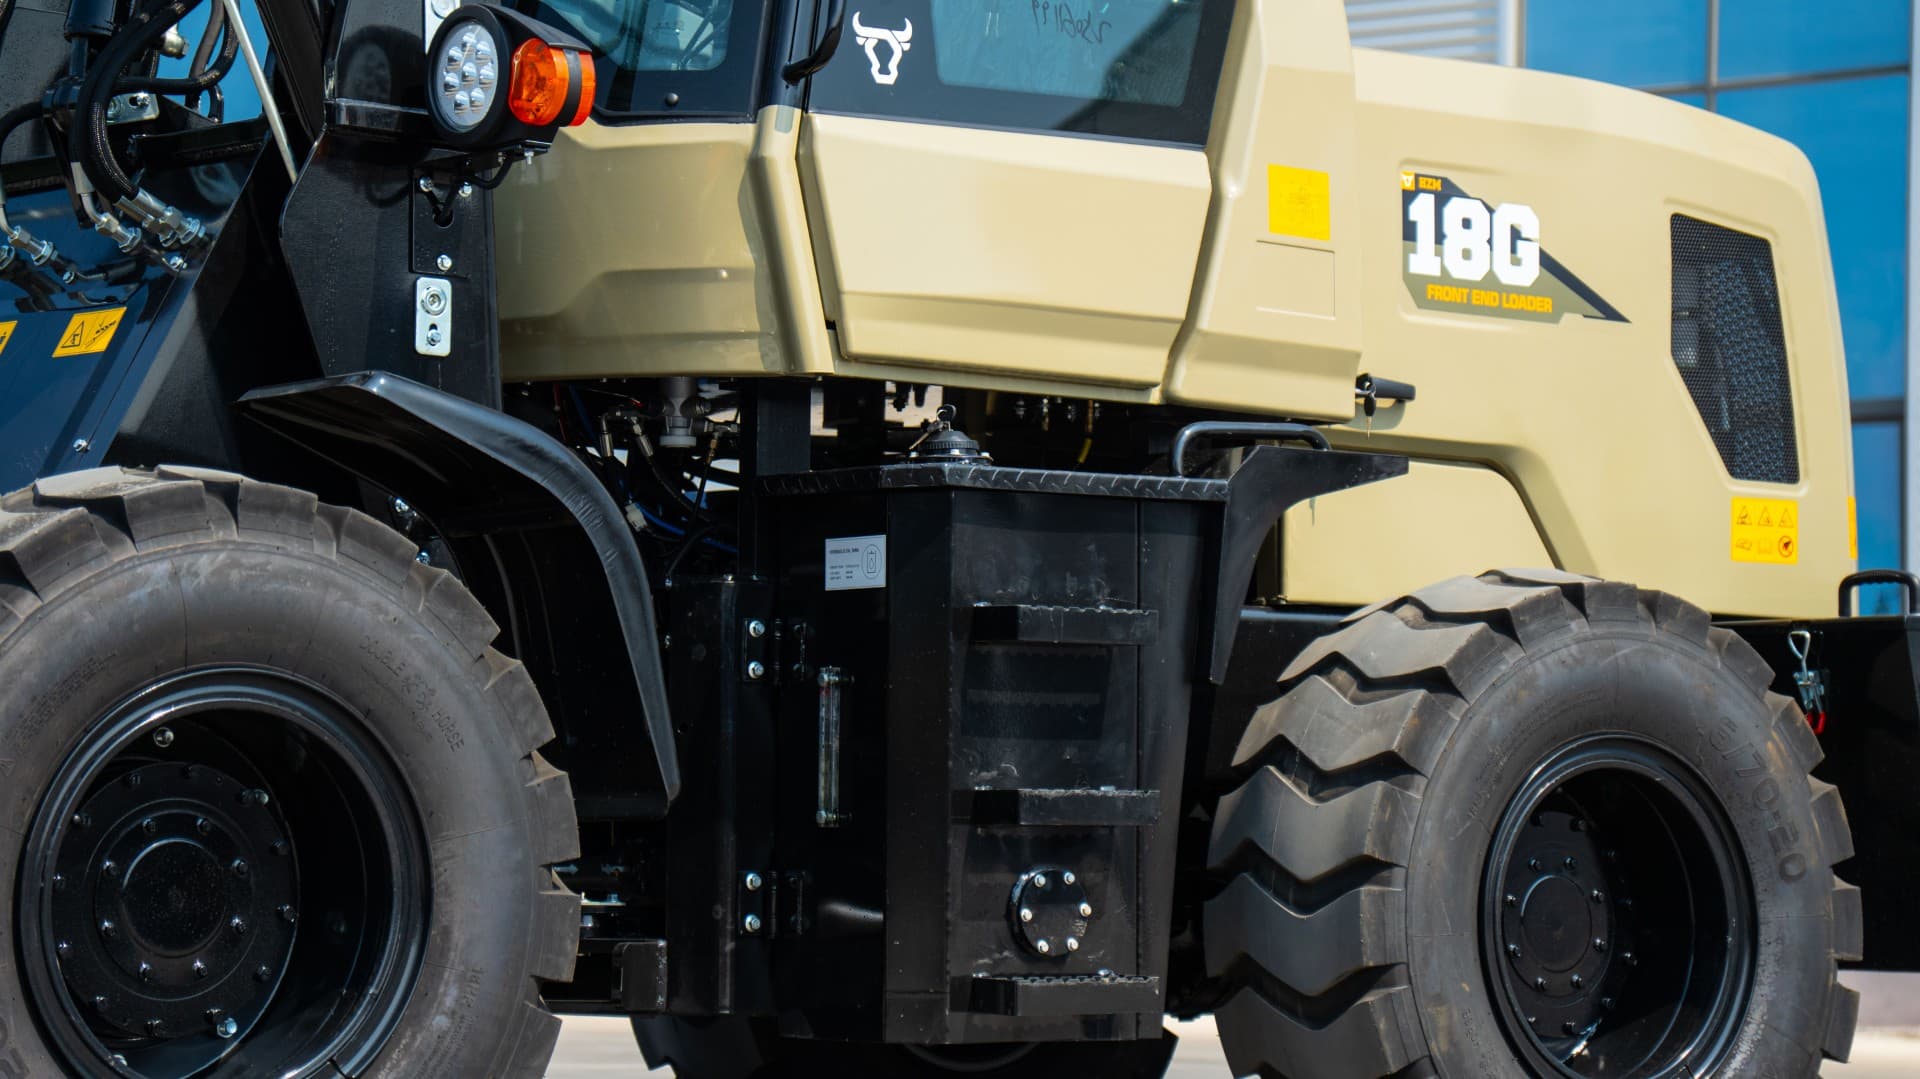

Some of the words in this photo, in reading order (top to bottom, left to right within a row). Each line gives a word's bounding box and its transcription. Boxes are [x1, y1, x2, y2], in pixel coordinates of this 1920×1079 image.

[1408, 192, 1540, 287] 18G
[1426, 283, 1469, 304] FRONT
[1471, 288, 1499, 307] END
[1501, 292, 1553, 313] LOADER
